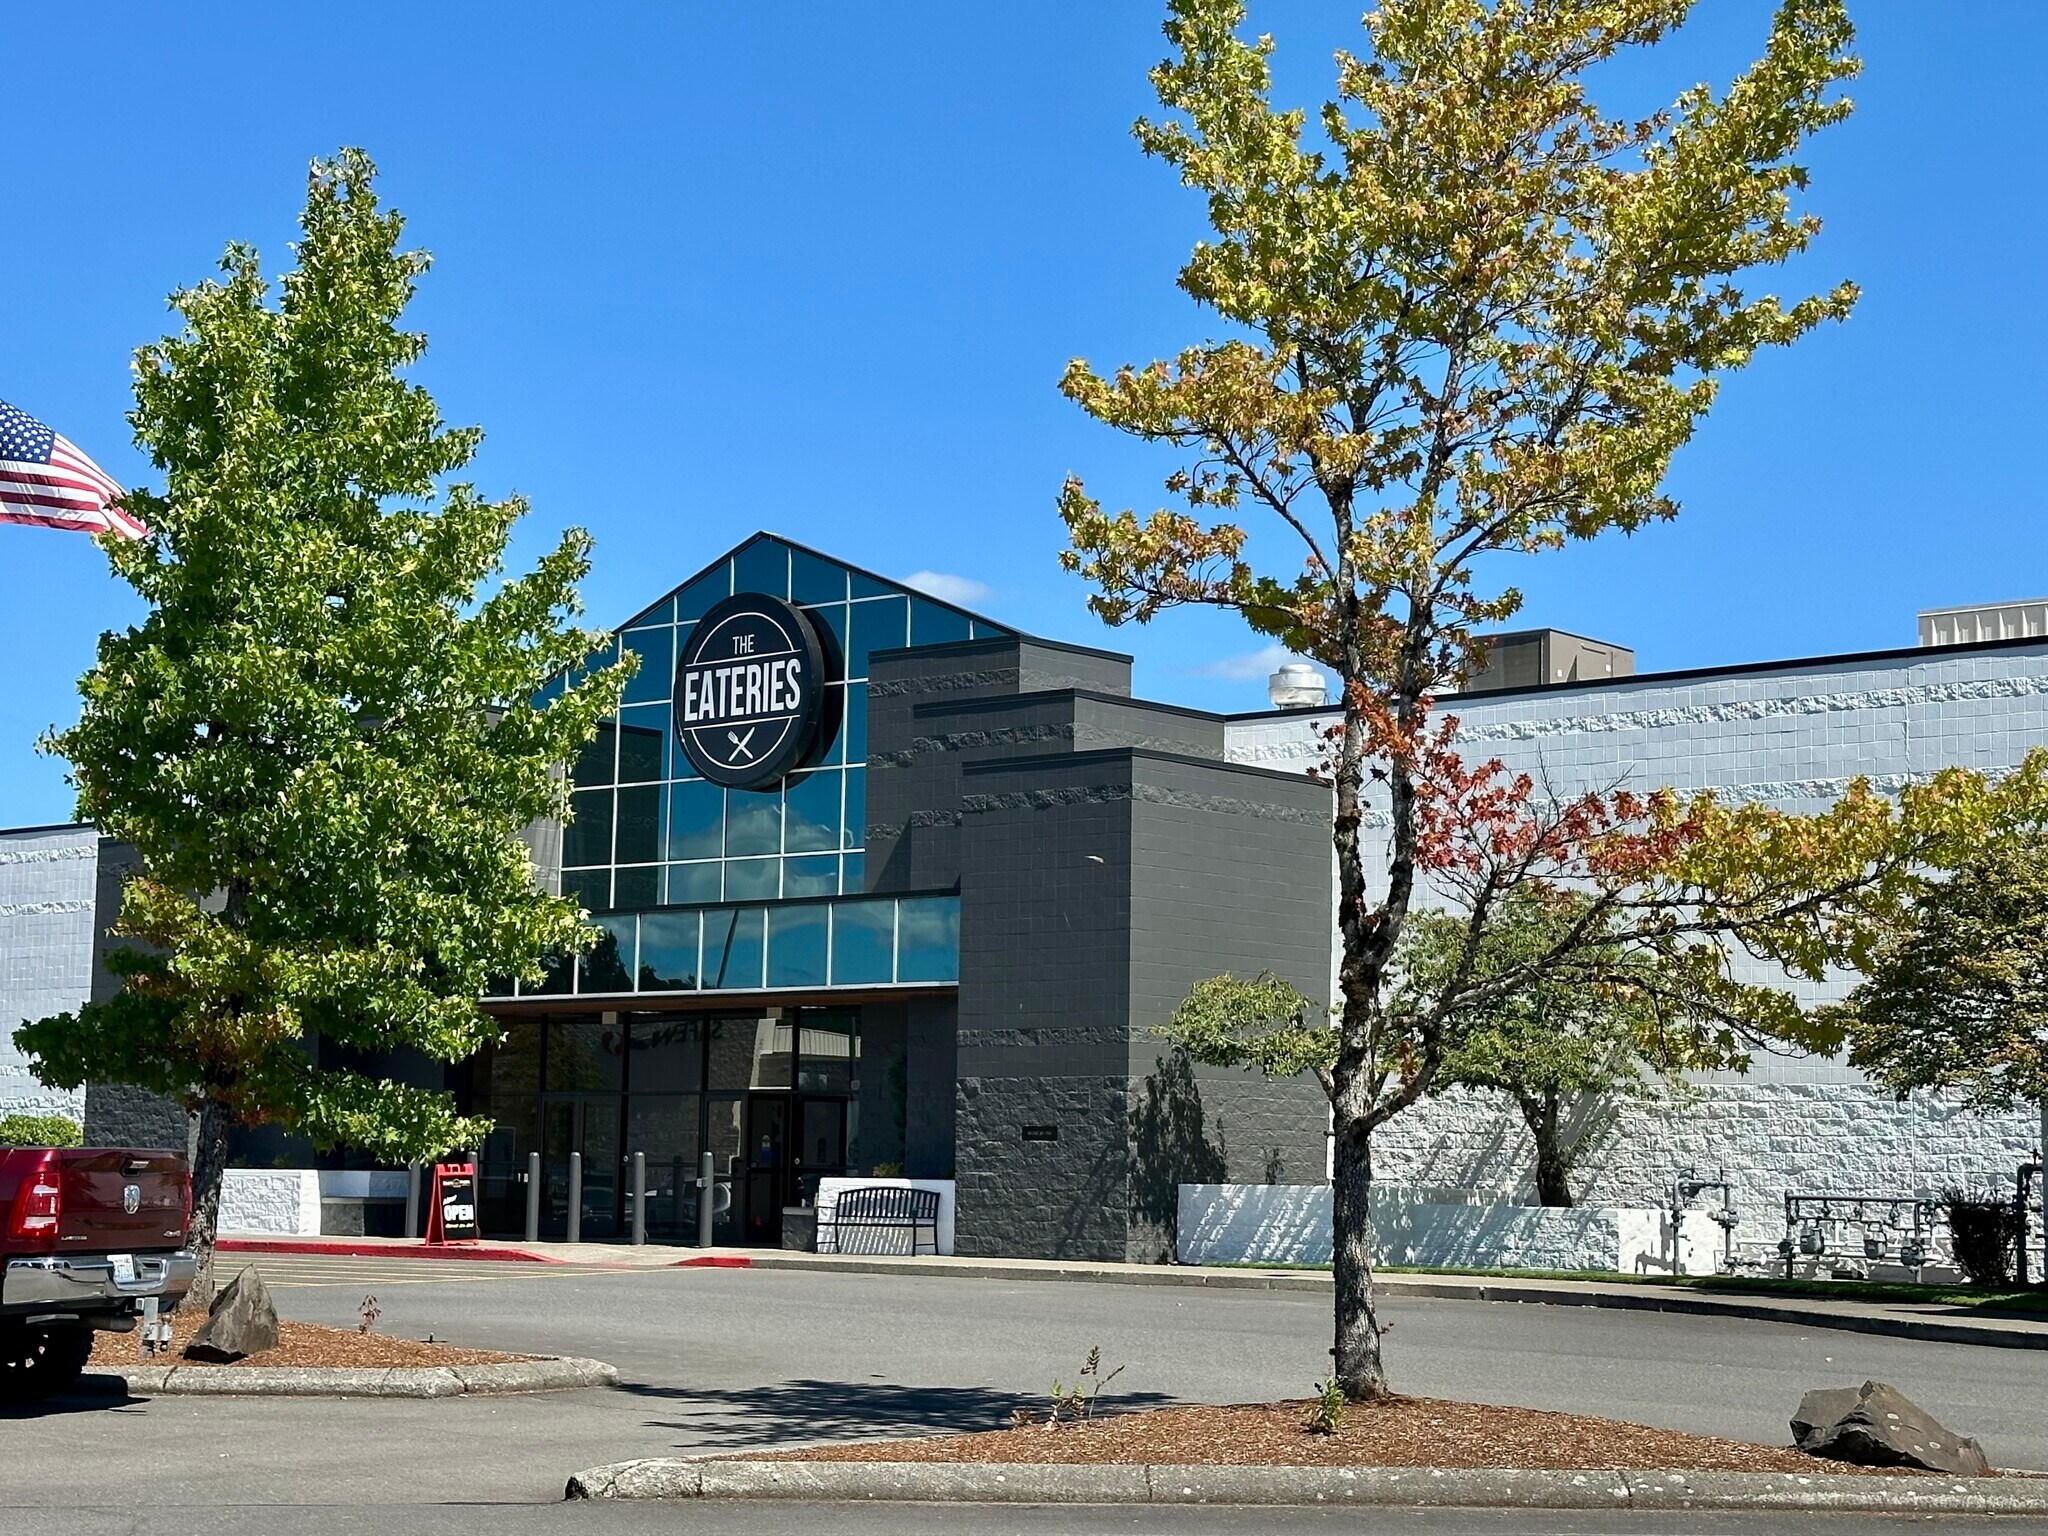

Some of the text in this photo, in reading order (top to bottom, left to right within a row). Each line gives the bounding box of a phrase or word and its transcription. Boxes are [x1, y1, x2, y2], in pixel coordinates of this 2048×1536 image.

[733, 634, 755, 655] THE
[684, 658, 801, 722] EATERIES
[444, 1204, 475, 1221] OPEN
